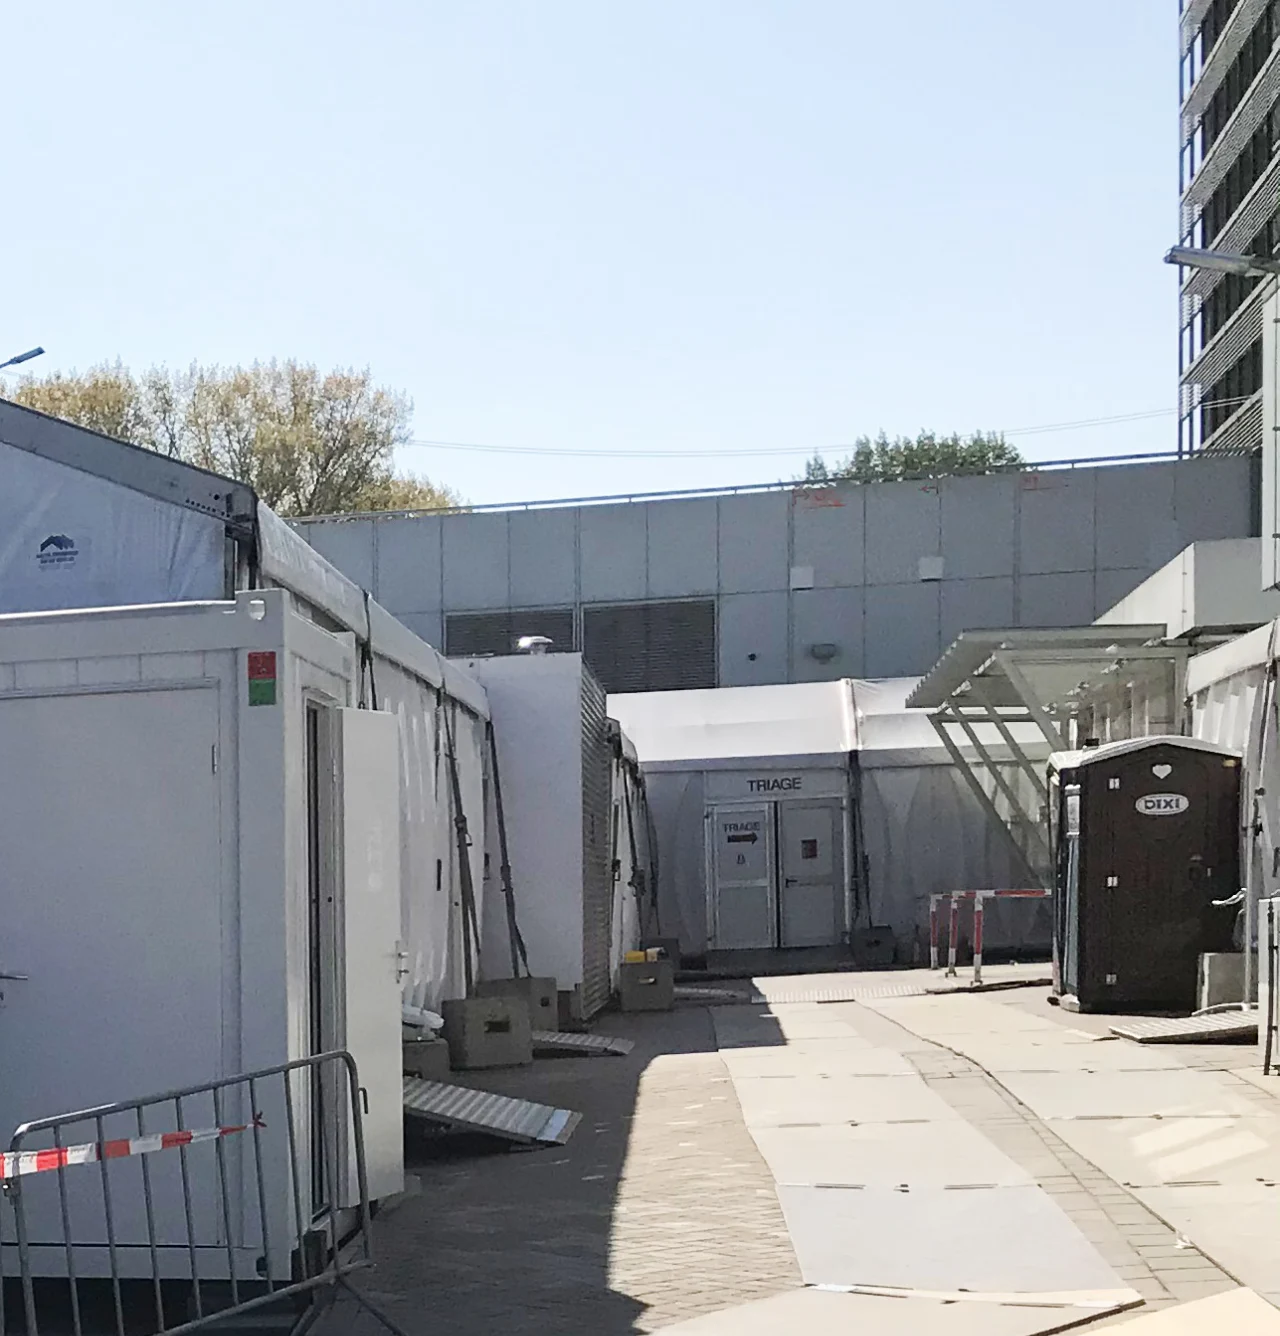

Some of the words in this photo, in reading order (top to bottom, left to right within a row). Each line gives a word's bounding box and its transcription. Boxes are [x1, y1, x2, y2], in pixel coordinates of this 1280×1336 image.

[746, 777, 802, 792] TRIAGE
[1144, 798, 1181, 810] DIXI
[723, 822, 761, 833] TRIAGE
